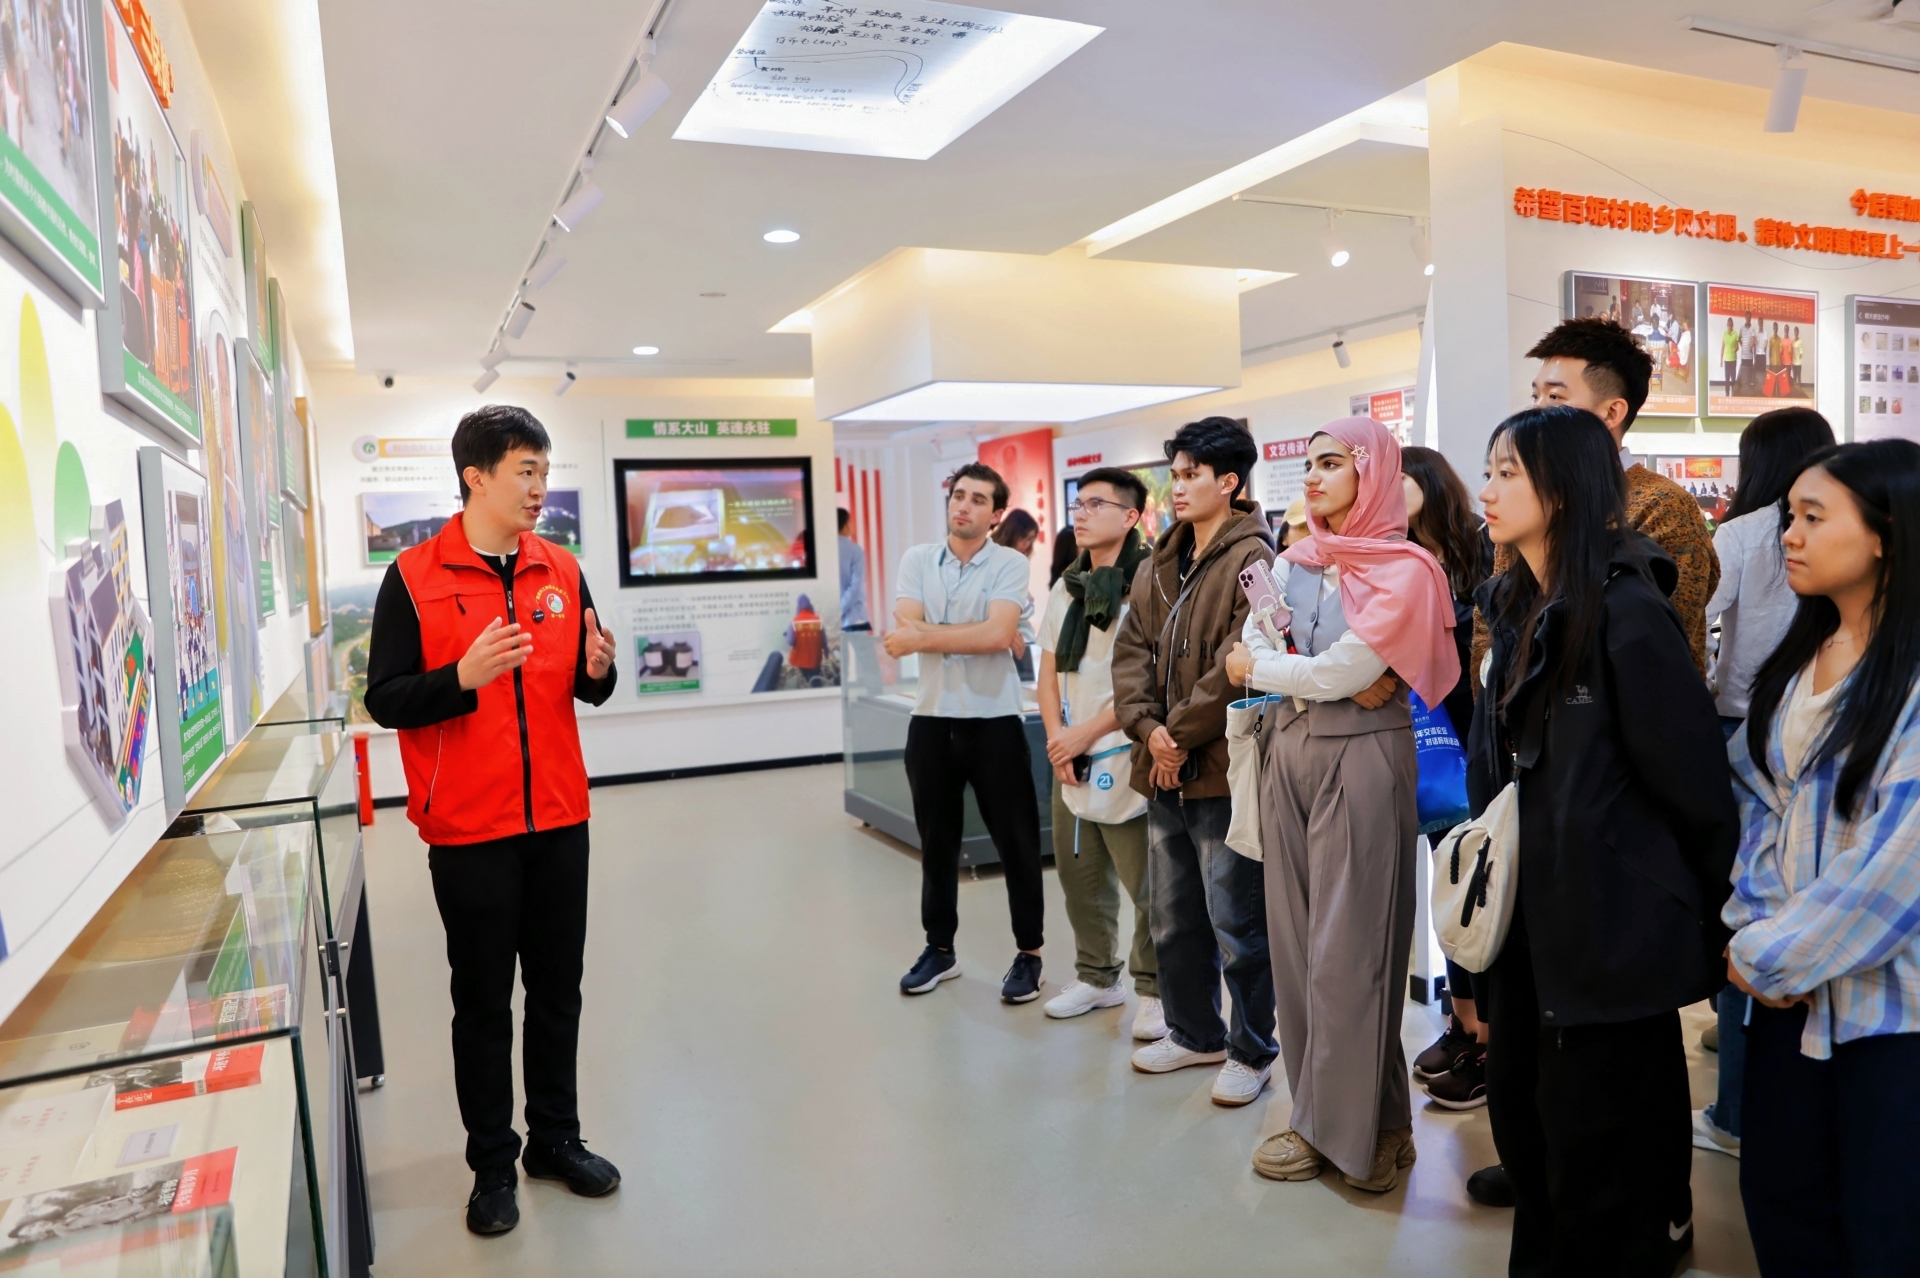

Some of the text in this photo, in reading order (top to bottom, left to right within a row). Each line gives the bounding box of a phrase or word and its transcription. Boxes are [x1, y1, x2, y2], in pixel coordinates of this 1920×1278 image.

[1514, 186, 1920, 262] 希望百坭村的乡风文明、精神文明建设更上一
[653, 421, 771, 436] 情系大山 英魂永驻
[1099, 775, 1111, 786] 21
